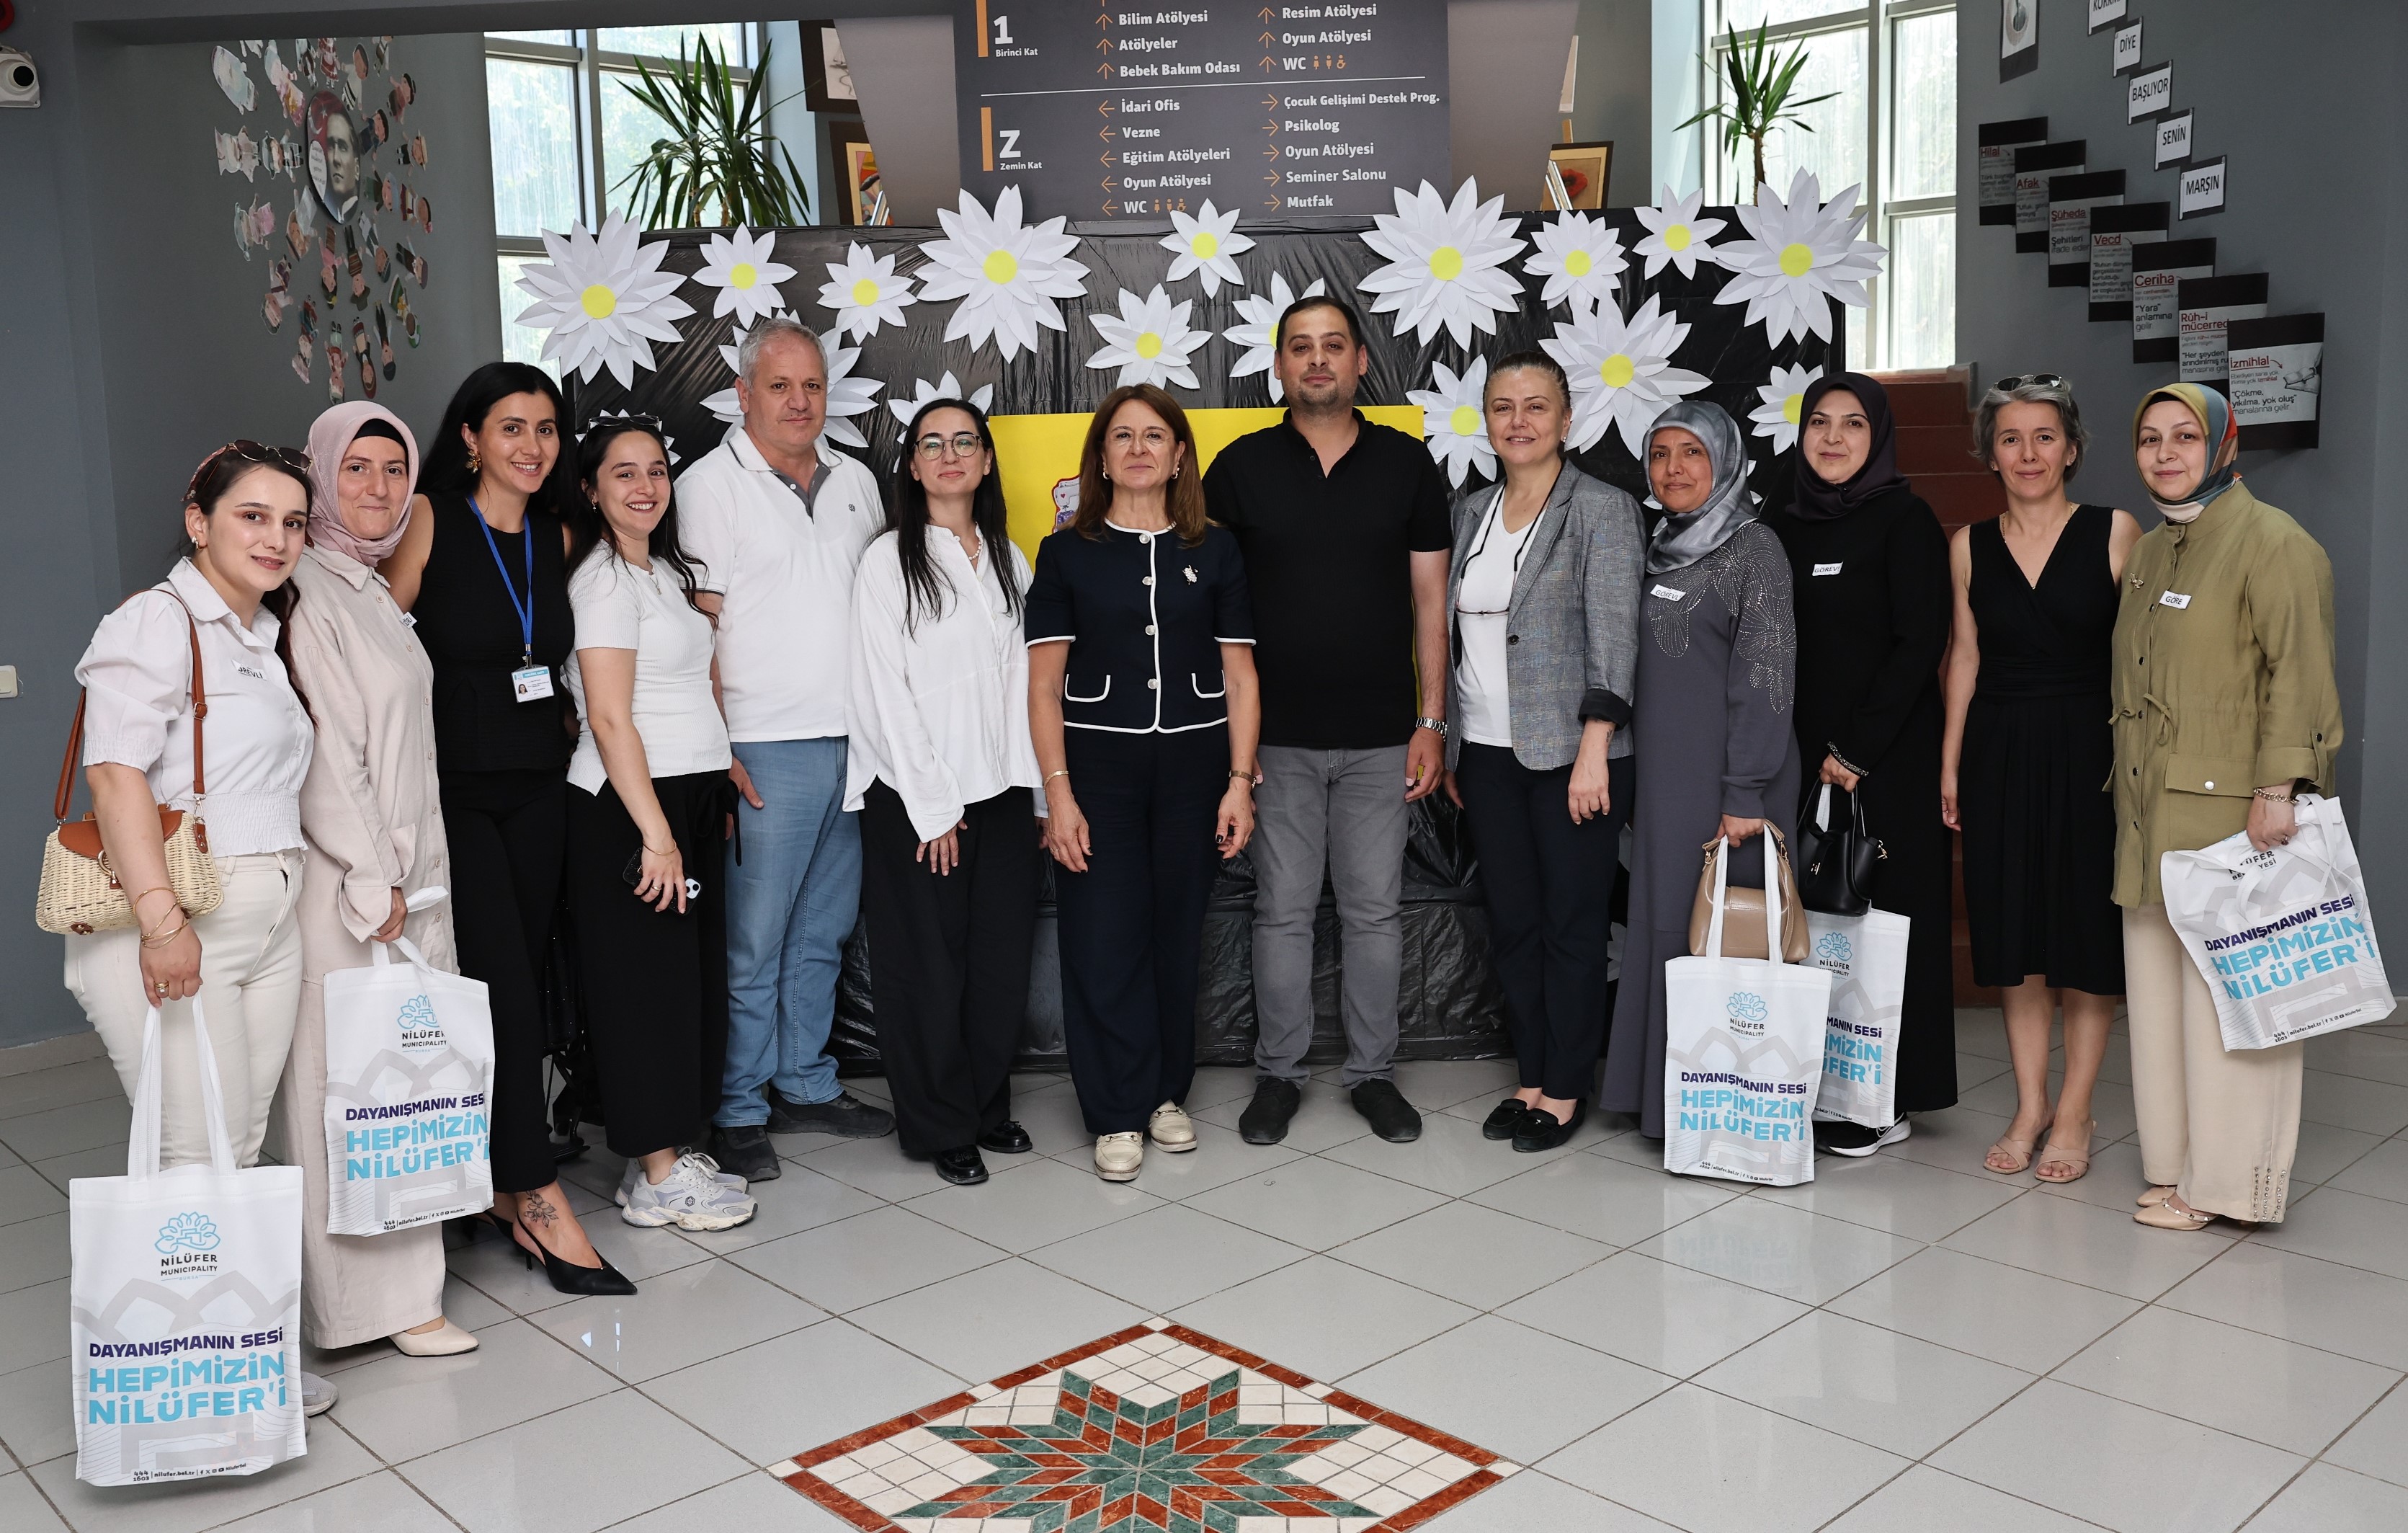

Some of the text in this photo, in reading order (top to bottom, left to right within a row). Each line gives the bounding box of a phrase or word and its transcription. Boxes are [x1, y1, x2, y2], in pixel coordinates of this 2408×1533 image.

[1118, 10, 1208, 26] Bilim Atölyesi
[1282, 3, 1377, 19] Resim Atölyesi
[994, 15, 1013, 44] 1
[1118, 37, 1177, 52] Atölyeler
[1283, 29, 1371, 47] Oyun Atölyesi
[2120, 35, 2136, 53] DİYE
[995, 48, 1038, 57] Birinci Kat
[1120, 61, 1240, 77] Bebek Bakım Odası
[1283, 57, 1306, 71] WC
[2133, 78, 2169, 102] BAŞLIYOR
[1121, 98, 1180, 113] İdari Ofis
[1284, 92, 1440, 109] Çocuk Gelişimi Destek Prog.
[1122, 126, 1161, 138] Vezne
[1285, 118, 1340, 133] Psikolog
[2162, 124, 2186, 146] SENİN
[999, 130, 1022, 159] Z
[1285, 142, 1374, 160] Oyun Atölyesi
[1980, 146, 2000, 157] Hilal
[1123, 148, 1231, 166] Eğitim Atölyeleri
[1000, 161, 1043, 171] Zemin Kat
[1123, 173, 1211, 191] Oyun Atölyesi
[1286, 168, 1386, 183] Seminer Salonu
[2017, 177, 2040, 189] Afak
[2185, 174, 2219, 195] MARŞIN
[1124, 200, 1148, 214] WC
[1287, 195, 1334, 208] Mutfak
[2094, 234, 2121, 245] Vecd
[2135, 273, 2175, 287] Ceriha
[2203, 894, 2355, 951] DAYANIŞMANIN SESİ
[2210, 912, 2365, 976] HEPİMİZİN
[1819, 959, 1850, 971] NİLÜFER
[2222, 936, 2376, 1000] NİLÜFER'İ
[1729, 1026, 1765, 1037] MUNICIPALITY
[1730, 1018, 1765, 1030] NİLÜFER
[1854, 1024, 1882, 1039] SESİ
[402, 1040, 447, 1049] MUNICIPALITY
[1681, 1072, 1806, 1095] DAYANIŞMANIN SESİ
[346, 1097, 458, 1121] DAYANIŞMANIN
[1681, 1089, 1805, 1119] HEPİMİZİN
[347, 1111, 488, 1152] HEPİMİZİN
[1680, 1109, 1804, 1142] NİLÜFER'İ
[347, 1134, 489, 1181] NİLÜFER'İ
[161, 1253, 218, 1266] NİLÜFER
[161, 1266, 218, 1276] MUNICIPALITY
[89, 1327, 282, 1358] DAYANIŞMANIN SESİ
[89, 1351, 285, 1392] HEPİMİZİN
[89, 1377, 286, 1424] NİLÜFER'İ
